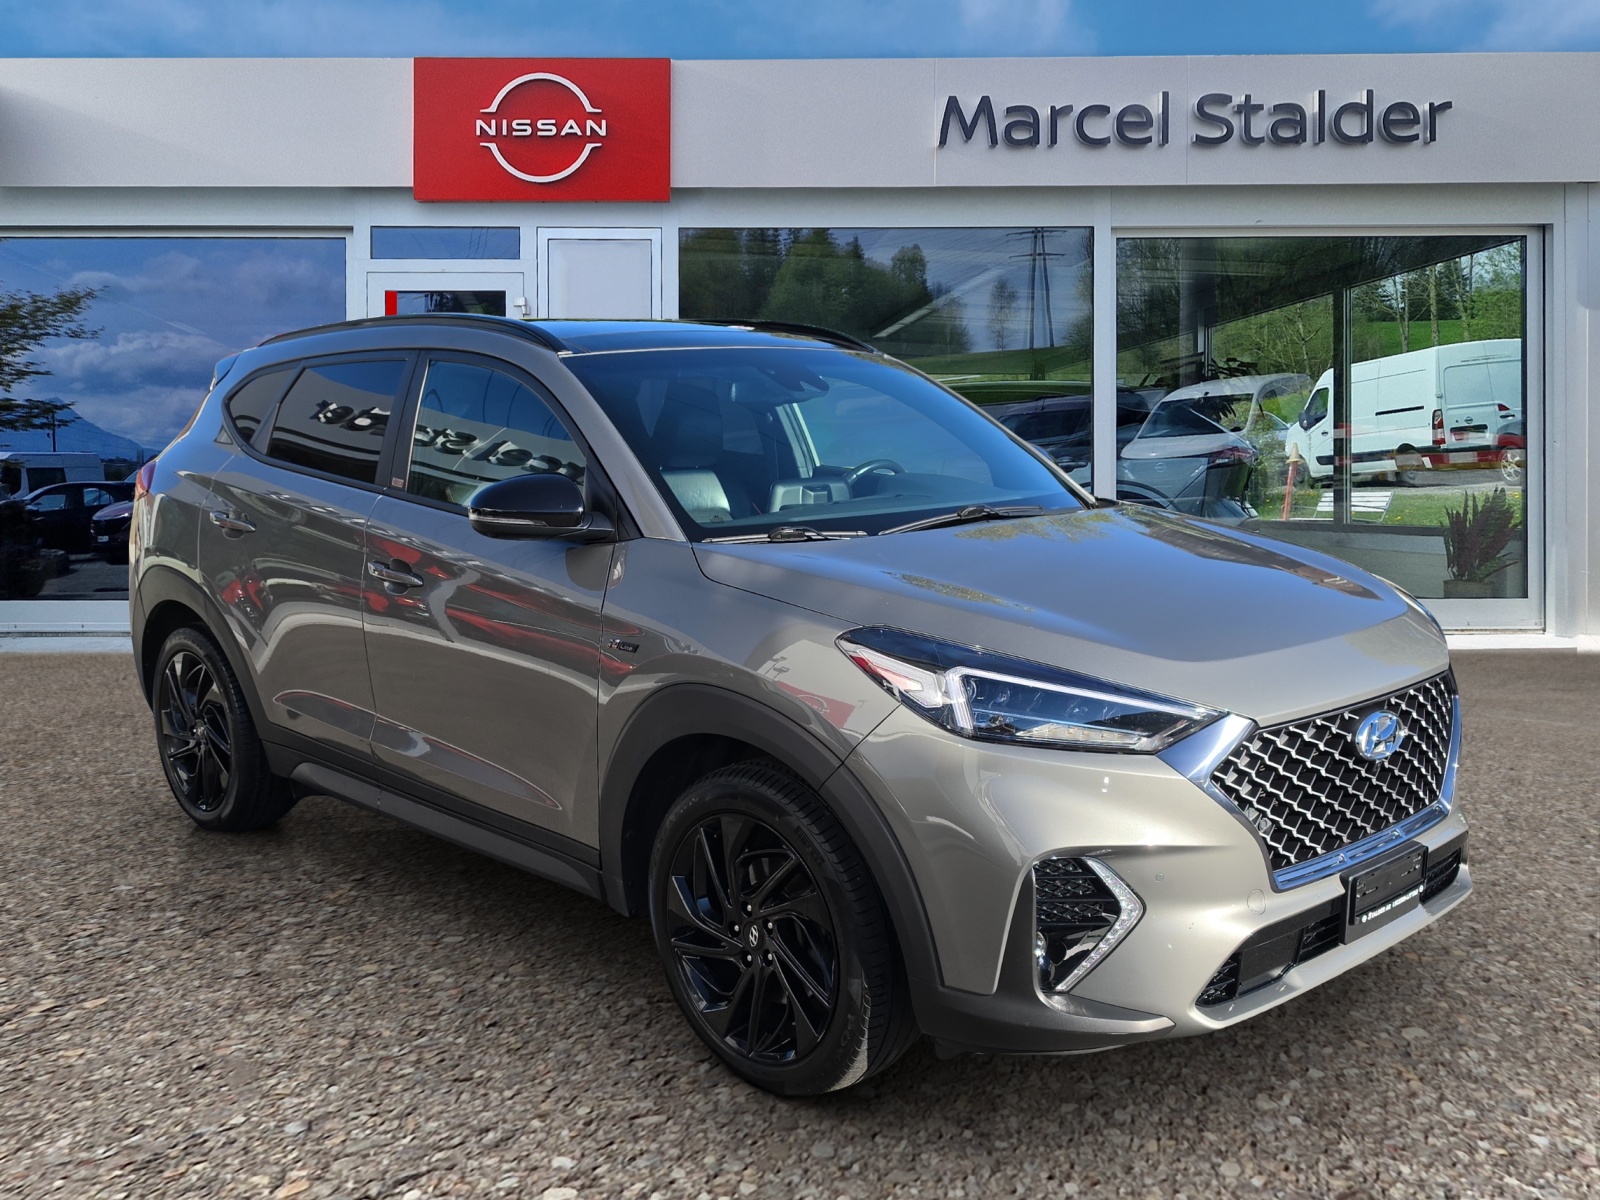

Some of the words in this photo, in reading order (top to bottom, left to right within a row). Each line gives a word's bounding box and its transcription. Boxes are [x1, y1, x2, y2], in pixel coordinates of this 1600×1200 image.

[475, 119, 607, 136] NISSAN
[937, 91, 1169, 148] Marcel
[1191, 89, 1453, 147] Stalder
